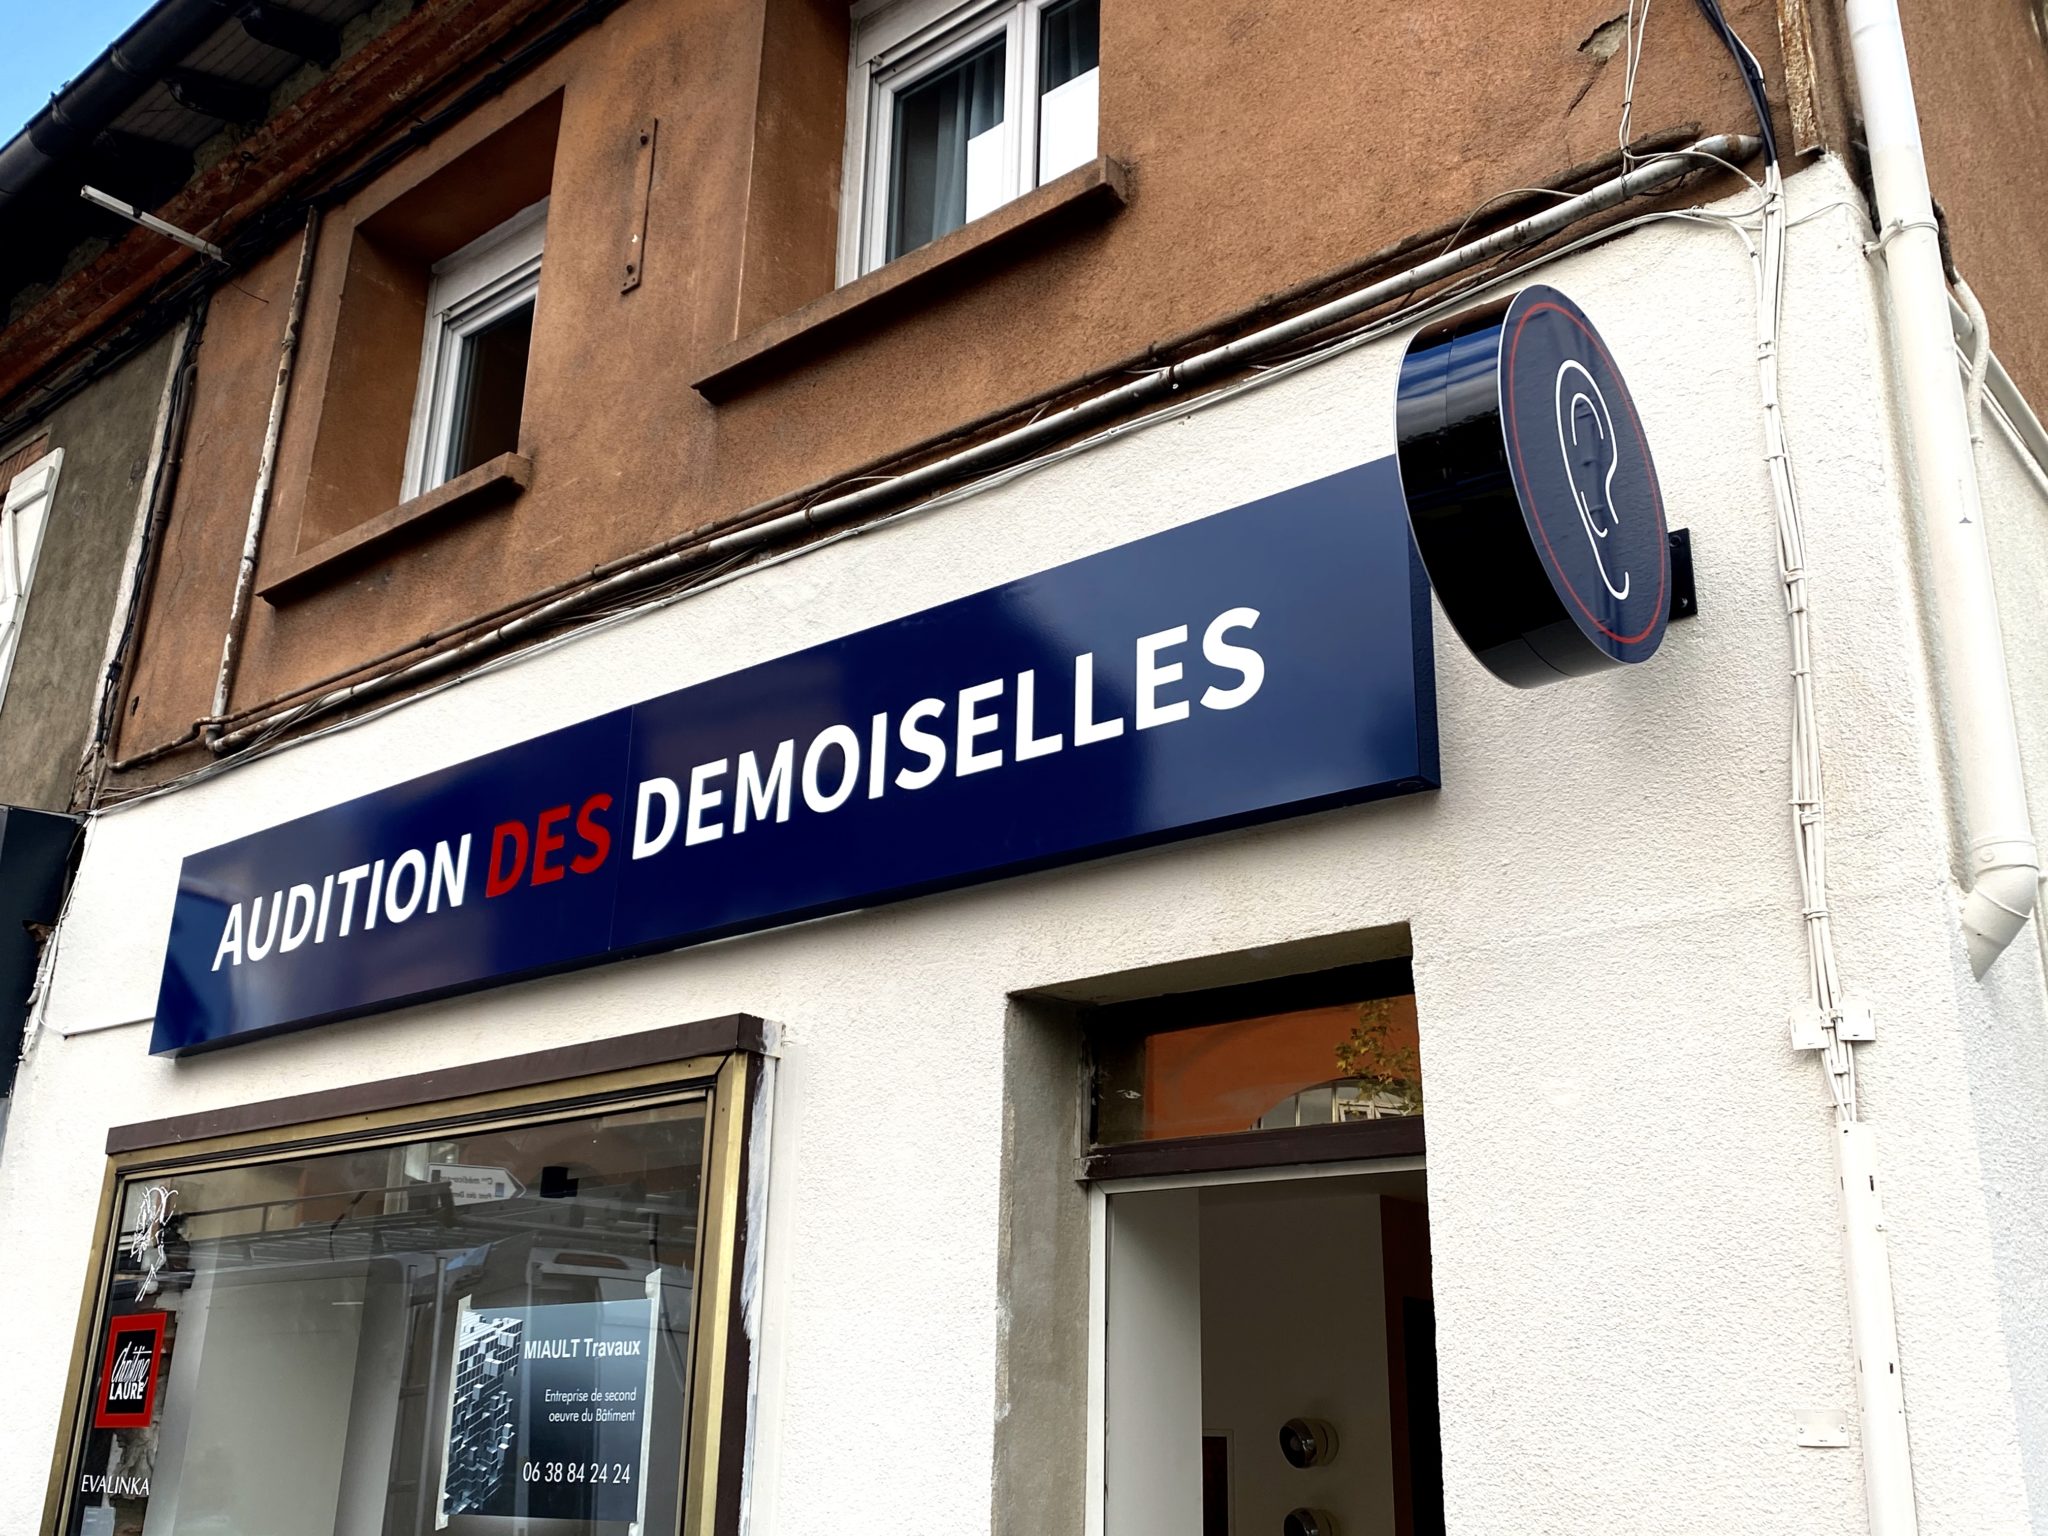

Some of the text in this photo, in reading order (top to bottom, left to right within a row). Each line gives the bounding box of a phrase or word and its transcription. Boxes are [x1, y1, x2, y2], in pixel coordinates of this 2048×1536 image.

[211, 607, 1266, 972] AUDITION DES DEMOISELLES
[524, 1338, 641, 1359] MIAULT Travaux
[109, 1382, 144, 1400] LAURE
[545, 1386, 637, 1405] Entreprise de second
[548, 1407, 636, 1422] oeuvre du Bâtiment
[522, 1461, 631, 1484] 06 38 84 24 24
[81, 1474, 150, 1496] EVALINKA
